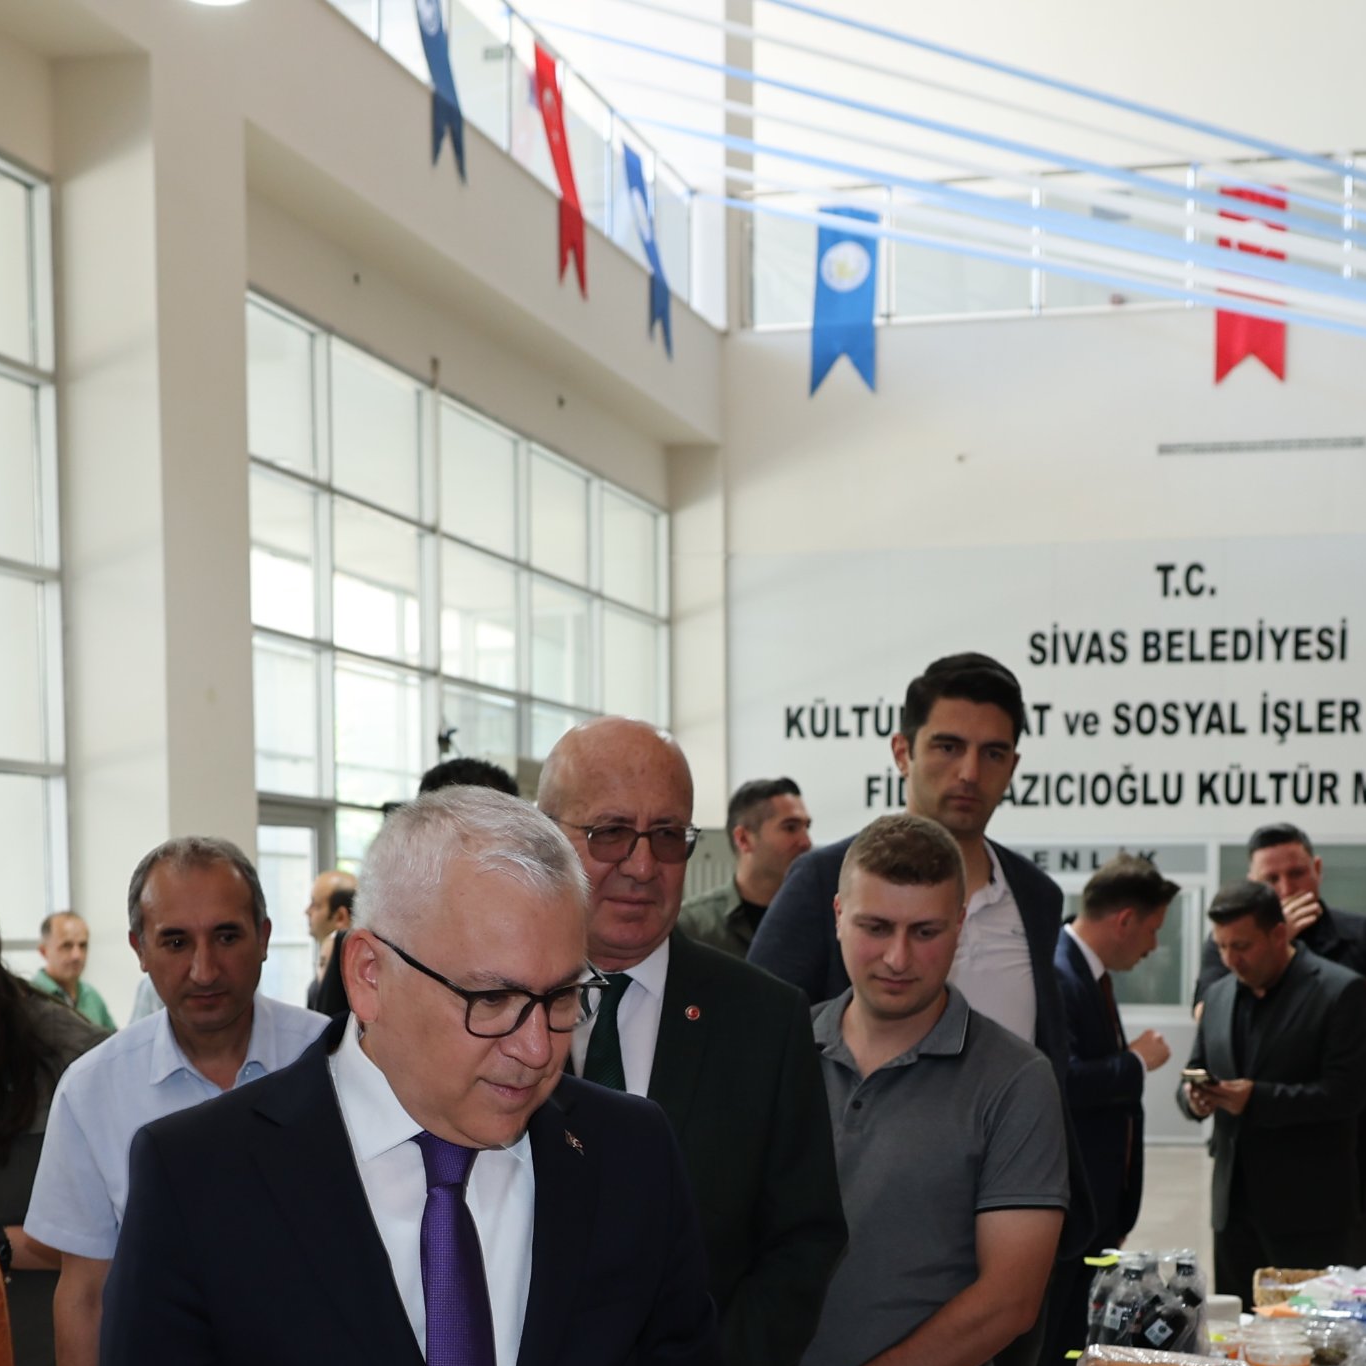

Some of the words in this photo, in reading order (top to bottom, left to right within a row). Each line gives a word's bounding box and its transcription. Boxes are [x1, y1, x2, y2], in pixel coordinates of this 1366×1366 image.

[1155, 562, 1217, 598] T.C.
[1028, 622, 1129, 666] SİVAS
[1141, 618, 1348, 664] BELEDİYESİ
[1063, 711, 1100, 737] ve
[1112, 701, 1248, 737] SOSYAL
[1259, 692, 1362, 745] İŞLER
[1002, 763, 1184, 808] AZICIOĞLU
[1196, 763, 1340, 806] KÜLTÜR
